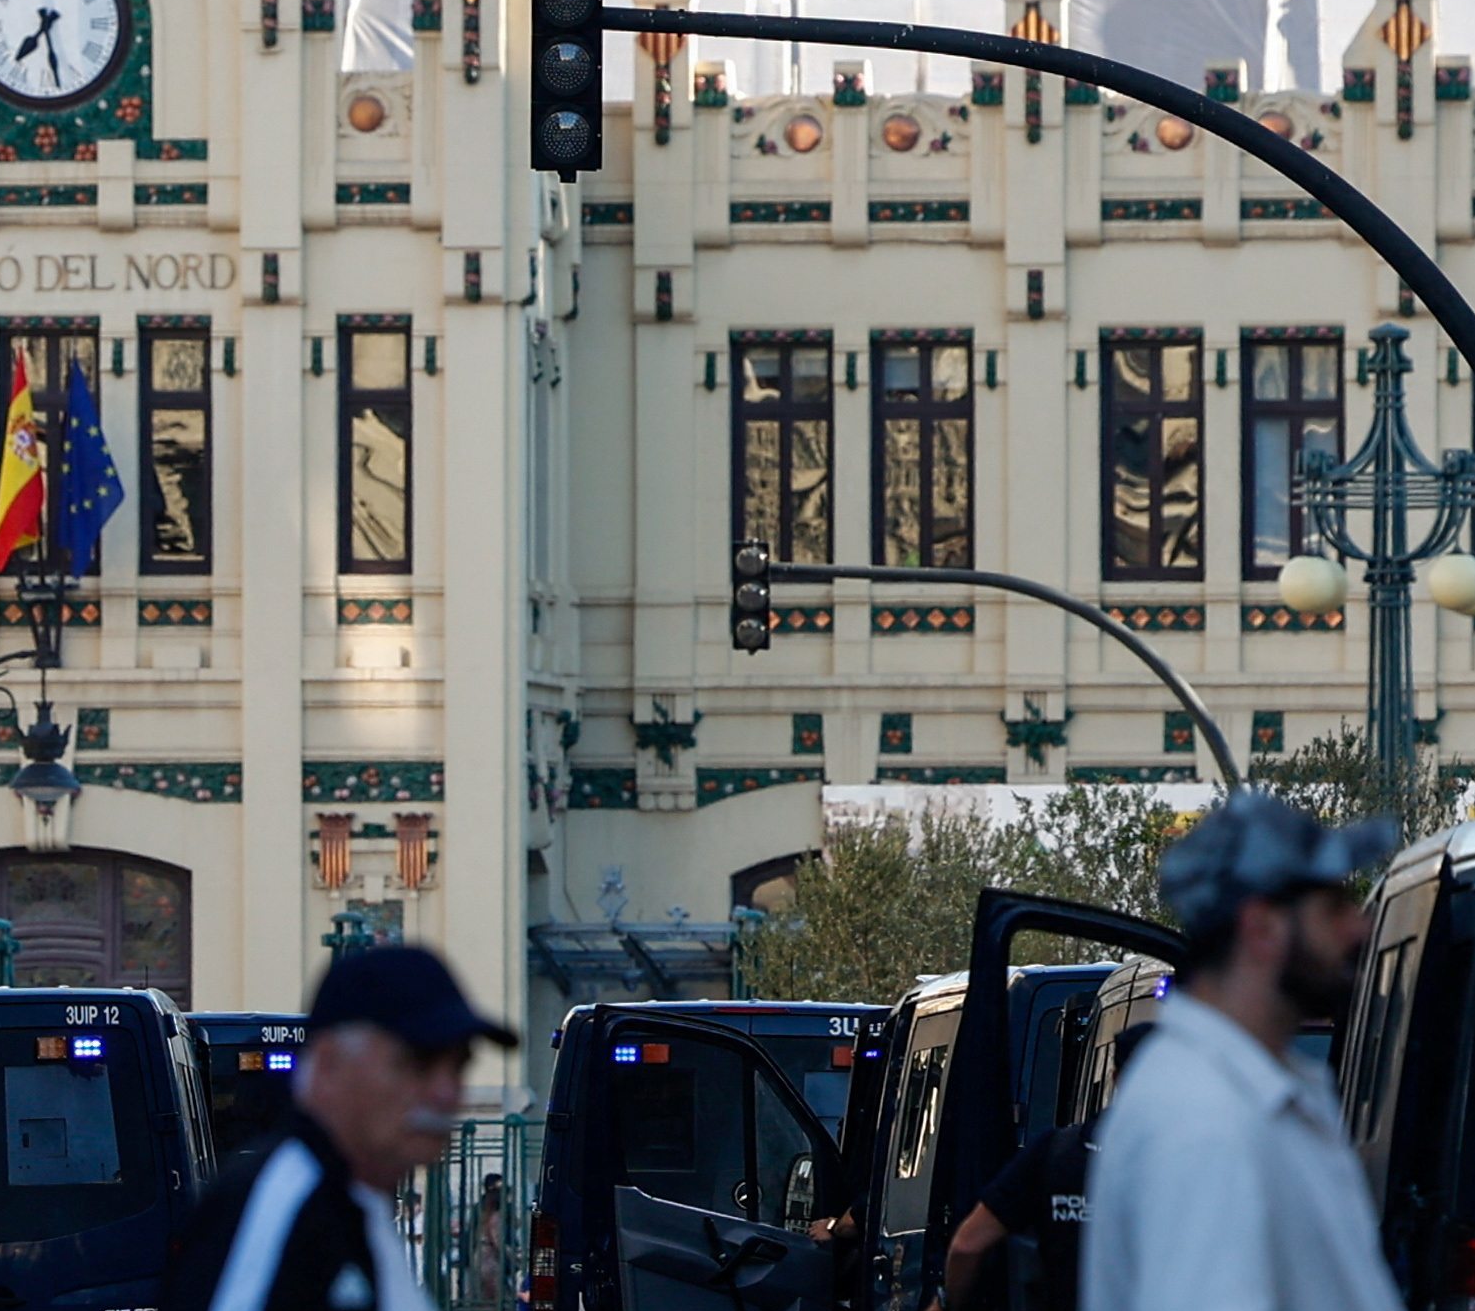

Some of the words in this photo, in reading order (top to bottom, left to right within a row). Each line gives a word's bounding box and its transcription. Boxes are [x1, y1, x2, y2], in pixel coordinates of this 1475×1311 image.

[34, 254, 115, 292] DEL
[124, 252, 238, 291] NORD
[65, 1006, 98, 1025] 3UIP
[103, 1006, 120, 1025] 12
[261, 1026, 305, 1043] 3UIP-10
[829, 1016, 859, 1036] 3U
[1052, 1195, 1094, 1208] POL
[1052, 1209, 1092, 1221] NAC
